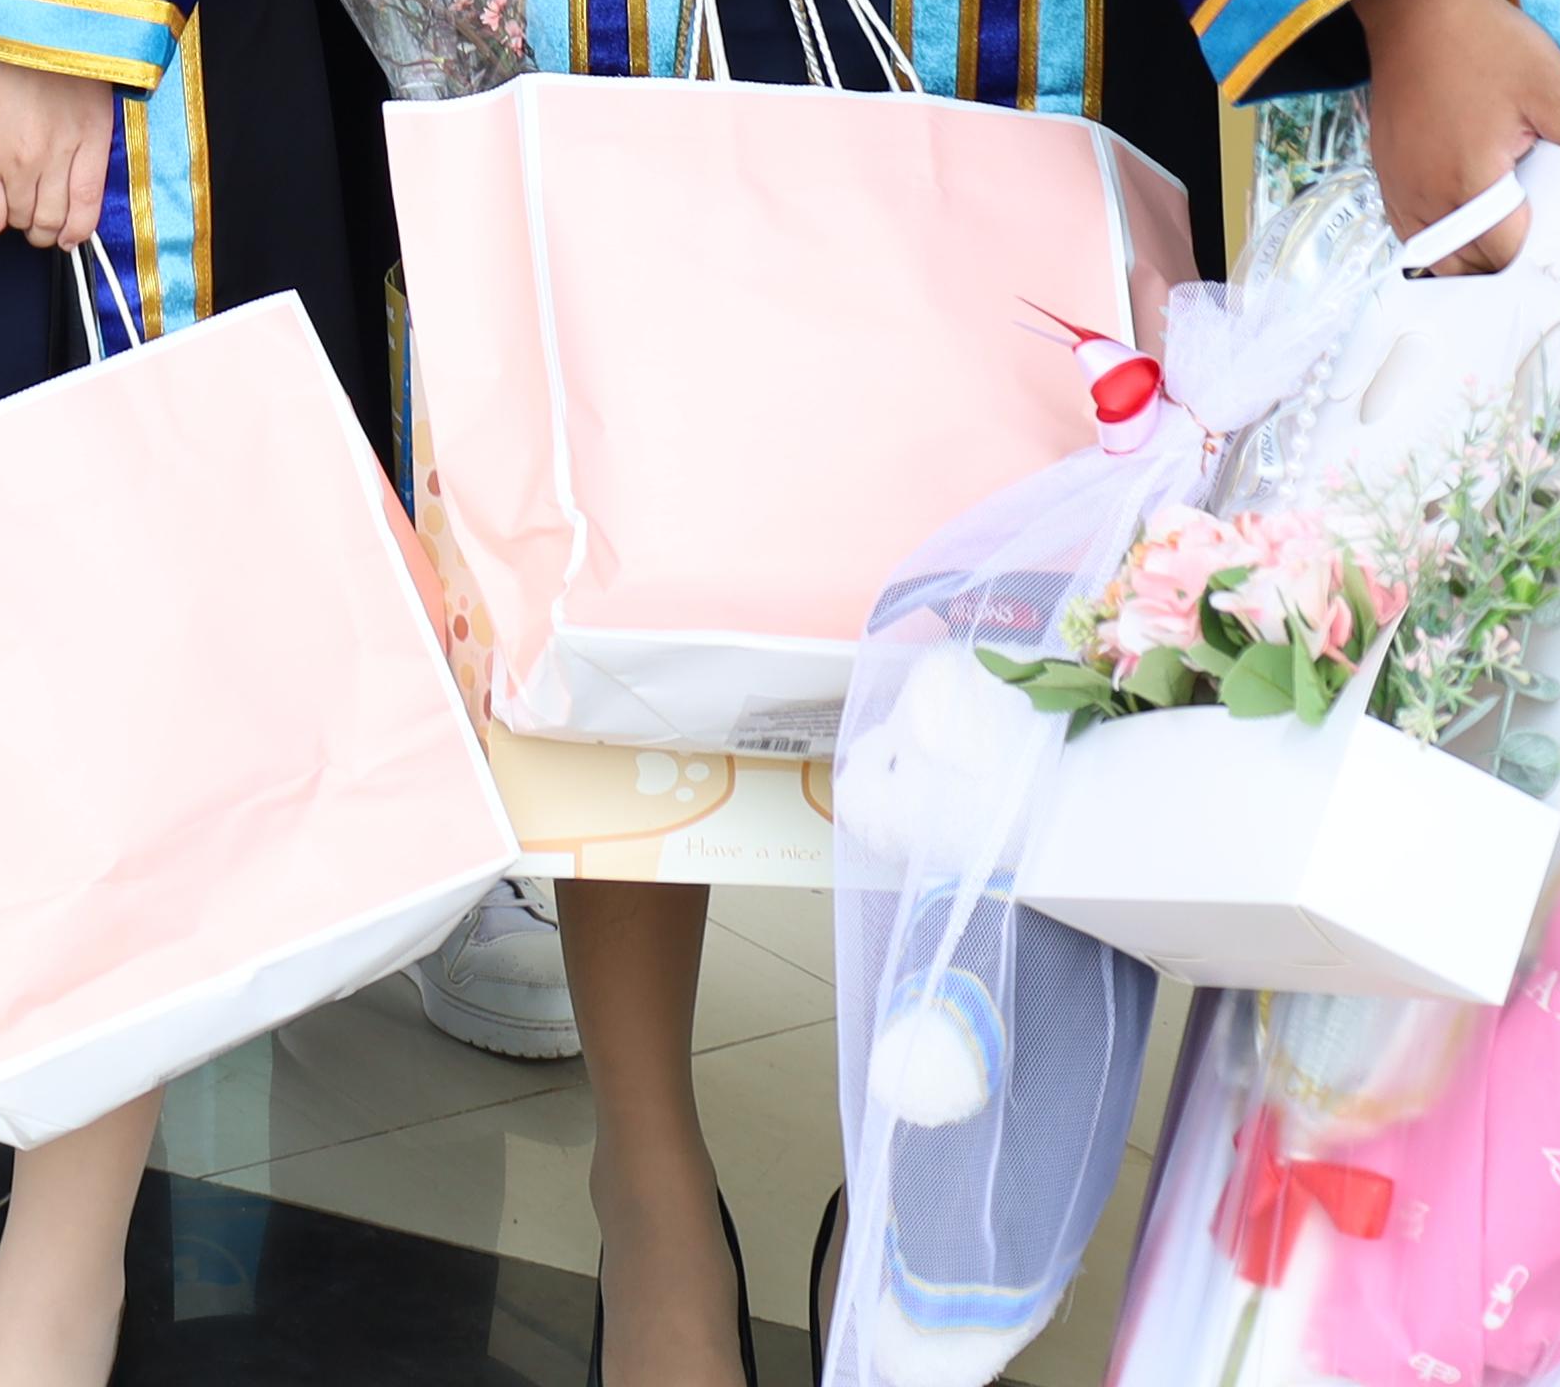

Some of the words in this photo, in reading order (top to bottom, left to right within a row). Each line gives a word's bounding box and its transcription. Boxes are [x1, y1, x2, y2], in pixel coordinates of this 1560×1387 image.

[686, 835, 743, 860] Have
[756, 846, 770, 860] a
[780, 843, 822, 862] nice
